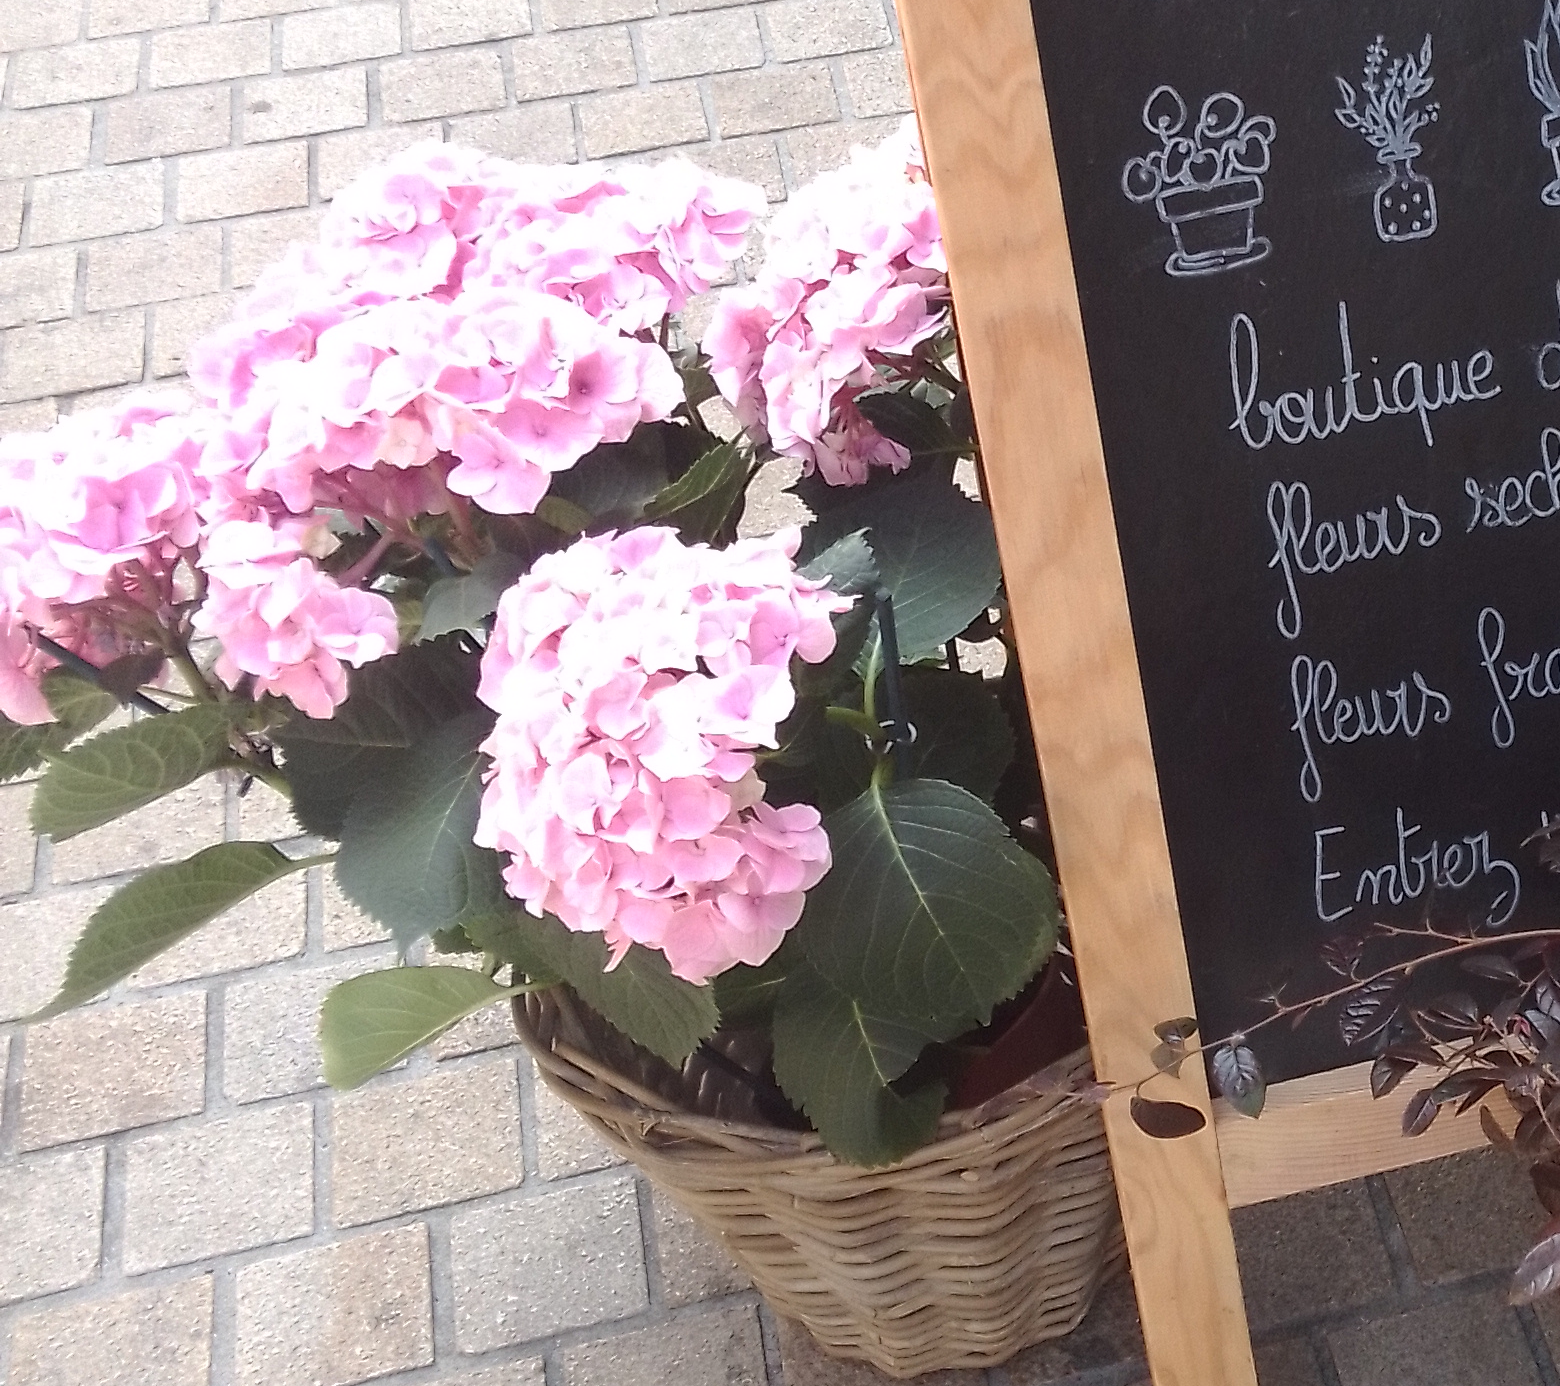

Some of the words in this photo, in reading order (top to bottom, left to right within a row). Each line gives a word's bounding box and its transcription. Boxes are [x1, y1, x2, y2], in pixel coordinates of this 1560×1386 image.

[1229, 301, 1502, 449] boutique
[1267, 481, 1441, 639] fleurs
[1291, 655, 1451, 802] fleurs
[1315, 807, 1520, 926] Entrez
